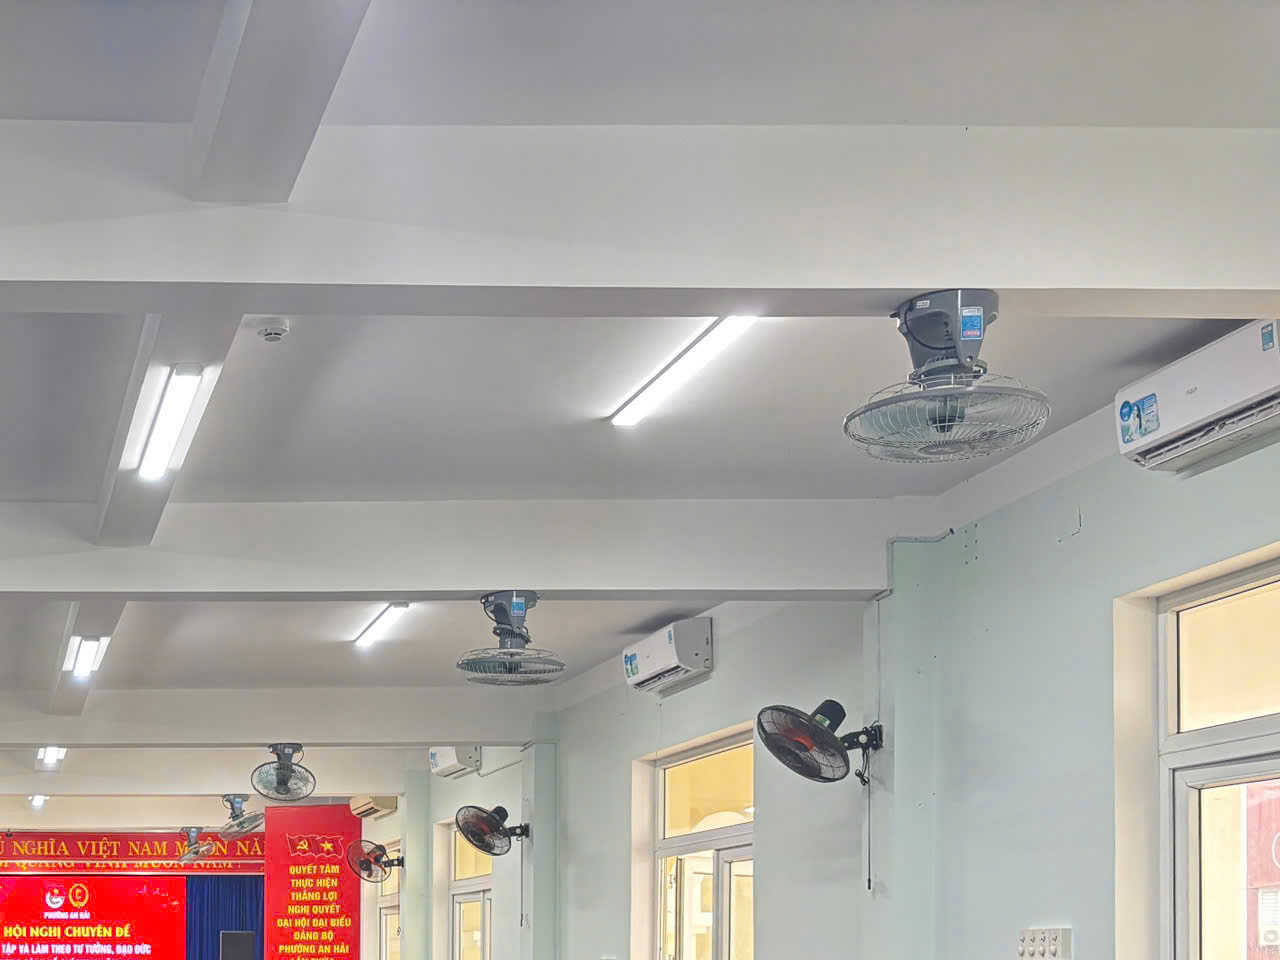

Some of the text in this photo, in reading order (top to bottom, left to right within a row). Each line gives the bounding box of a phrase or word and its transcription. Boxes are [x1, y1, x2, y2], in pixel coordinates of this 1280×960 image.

[13, 838, 69, 856] NGHĨA
[77, 837, 120, 858] VIỆT
[128, 841, 168, 856] NAM
[176, 837, 228, 856] MÔN
[236, 836, 265, 856] NĂ
[3, 924, 26, 939] HỘI
[30, 926, 61, 939] NGHỊ
[64, 924, 112, 937] CHUYÊN
[52, 944, 71, 954] THEO
[318, 945, 331, 953] AN
